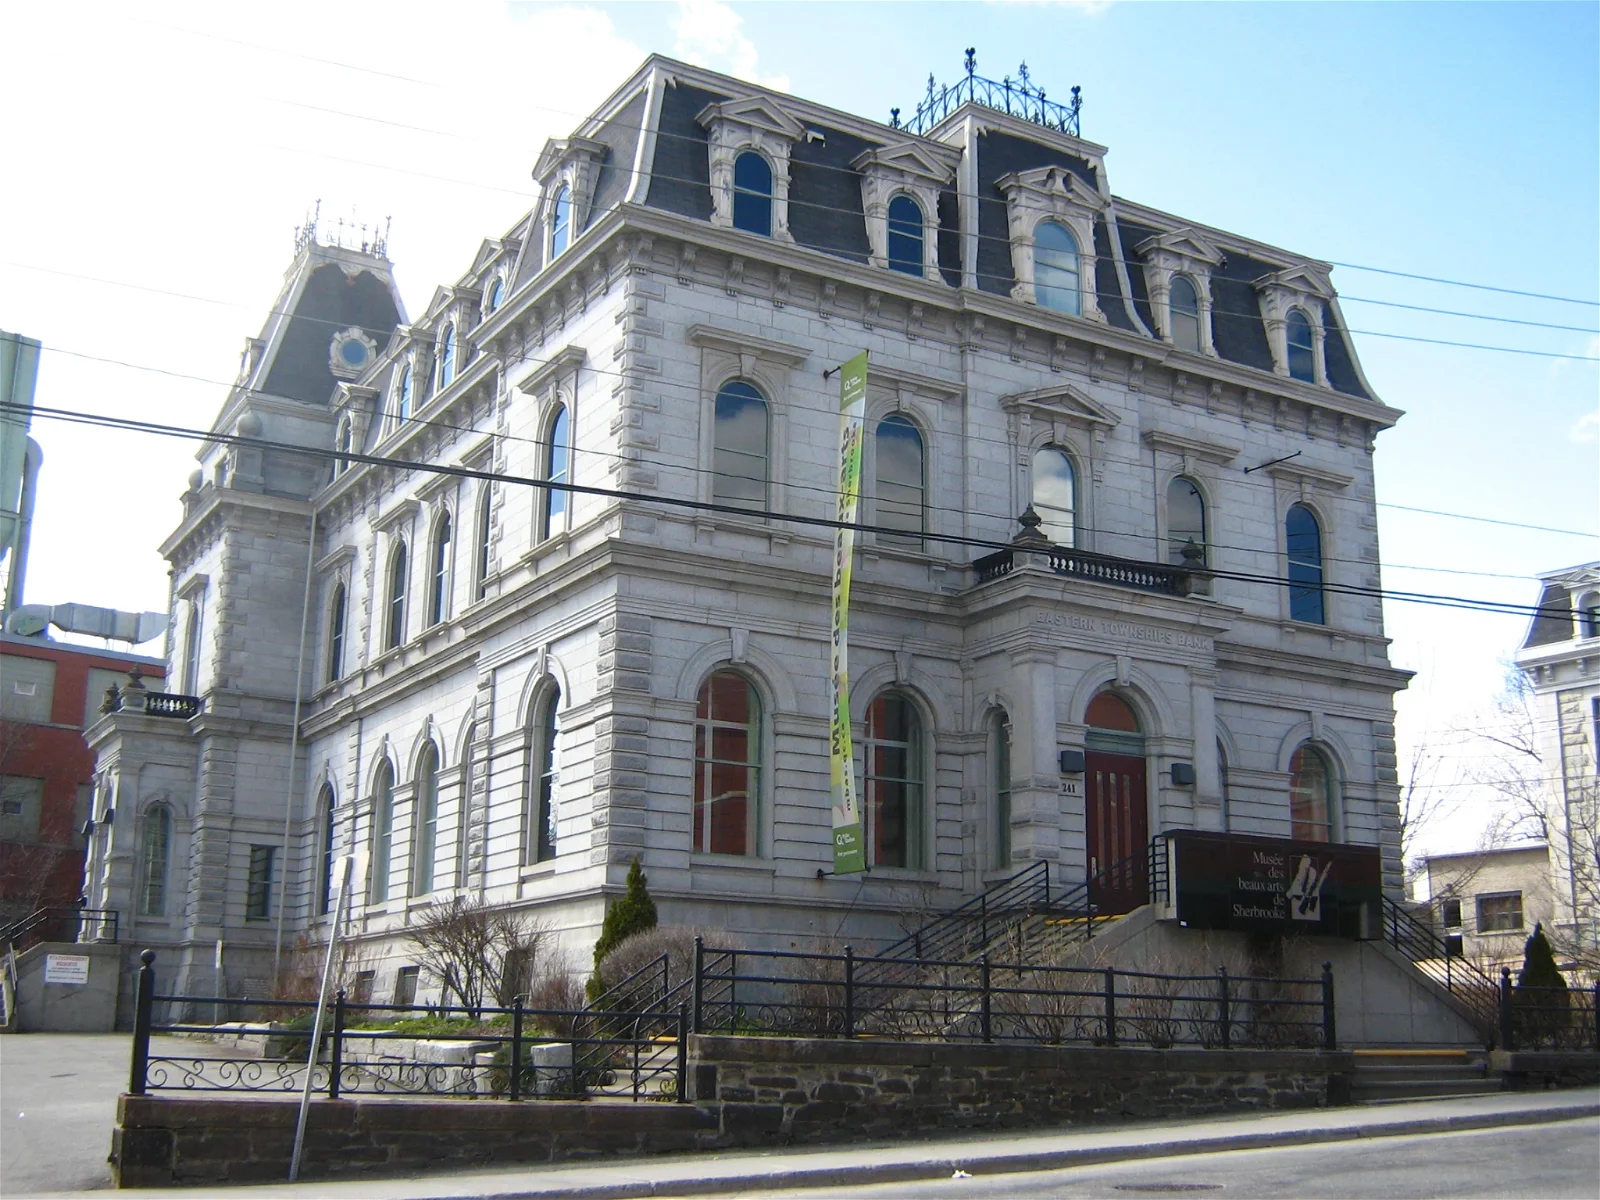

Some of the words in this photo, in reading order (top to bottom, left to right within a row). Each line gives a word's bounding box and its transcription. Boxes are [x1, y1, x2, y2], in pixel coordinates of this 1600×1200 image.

[1036, 612, 1095, 632] EASTERN
[1102, 622, 1172, 644] TOWNSHIPS
[1177, 636, 1211, 650] BANK
[832, 655, 840, 755] Musée
[841, 723, 851, 811] mbas.qc.ca
[1062, 783, 1076, 793] 241
[1253, 851, 1284, 866] Musée
[1268, 866, 1284, 879] des
[1238, 877, 1266, 891] beaux
[1267, 881, 1284, 892] arts
[1273, 893, 1284, 905] de
[1232, 903, 1285, 919] Sherbrooke
